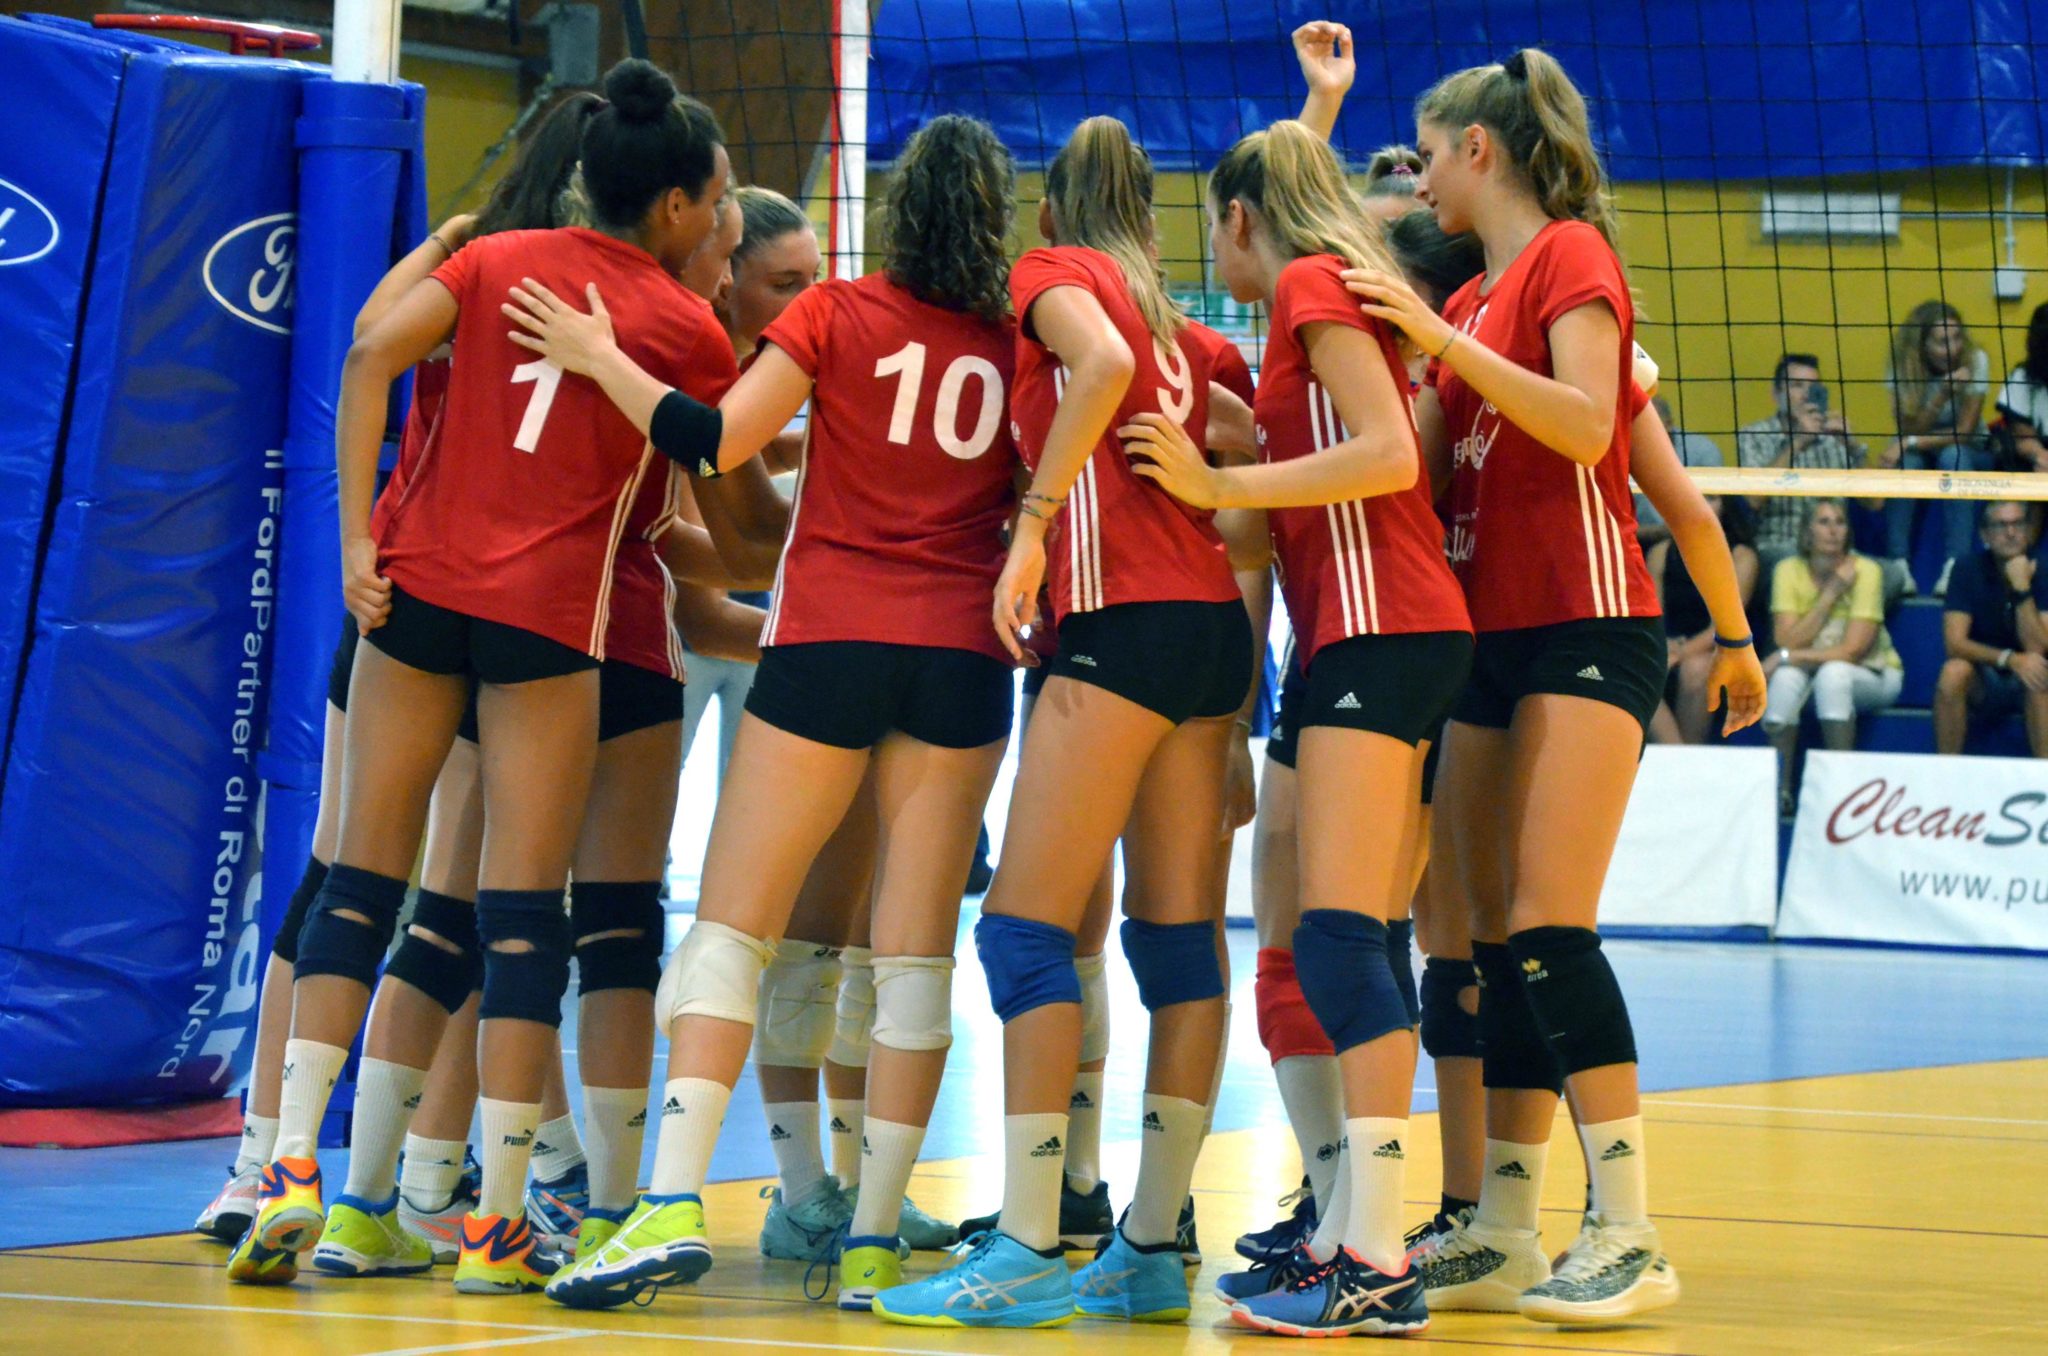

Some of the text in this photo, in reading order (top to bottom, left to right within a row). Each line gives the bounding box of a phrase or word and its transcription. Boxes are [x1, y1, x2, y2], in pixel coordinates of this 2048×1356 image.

[510, 358, 563, 454] 1
[874, 341, 1004, 460] 10
[1152, 334, 1194, 425] 9
[224, 775, 249, 813] di
[202, 831, 244, 967] Roma
[157, 984, 217, 1078] Nord
[1373, 1150, 1405, 1160] adidas
[1495, 1169, 1531, 1181] adidas
